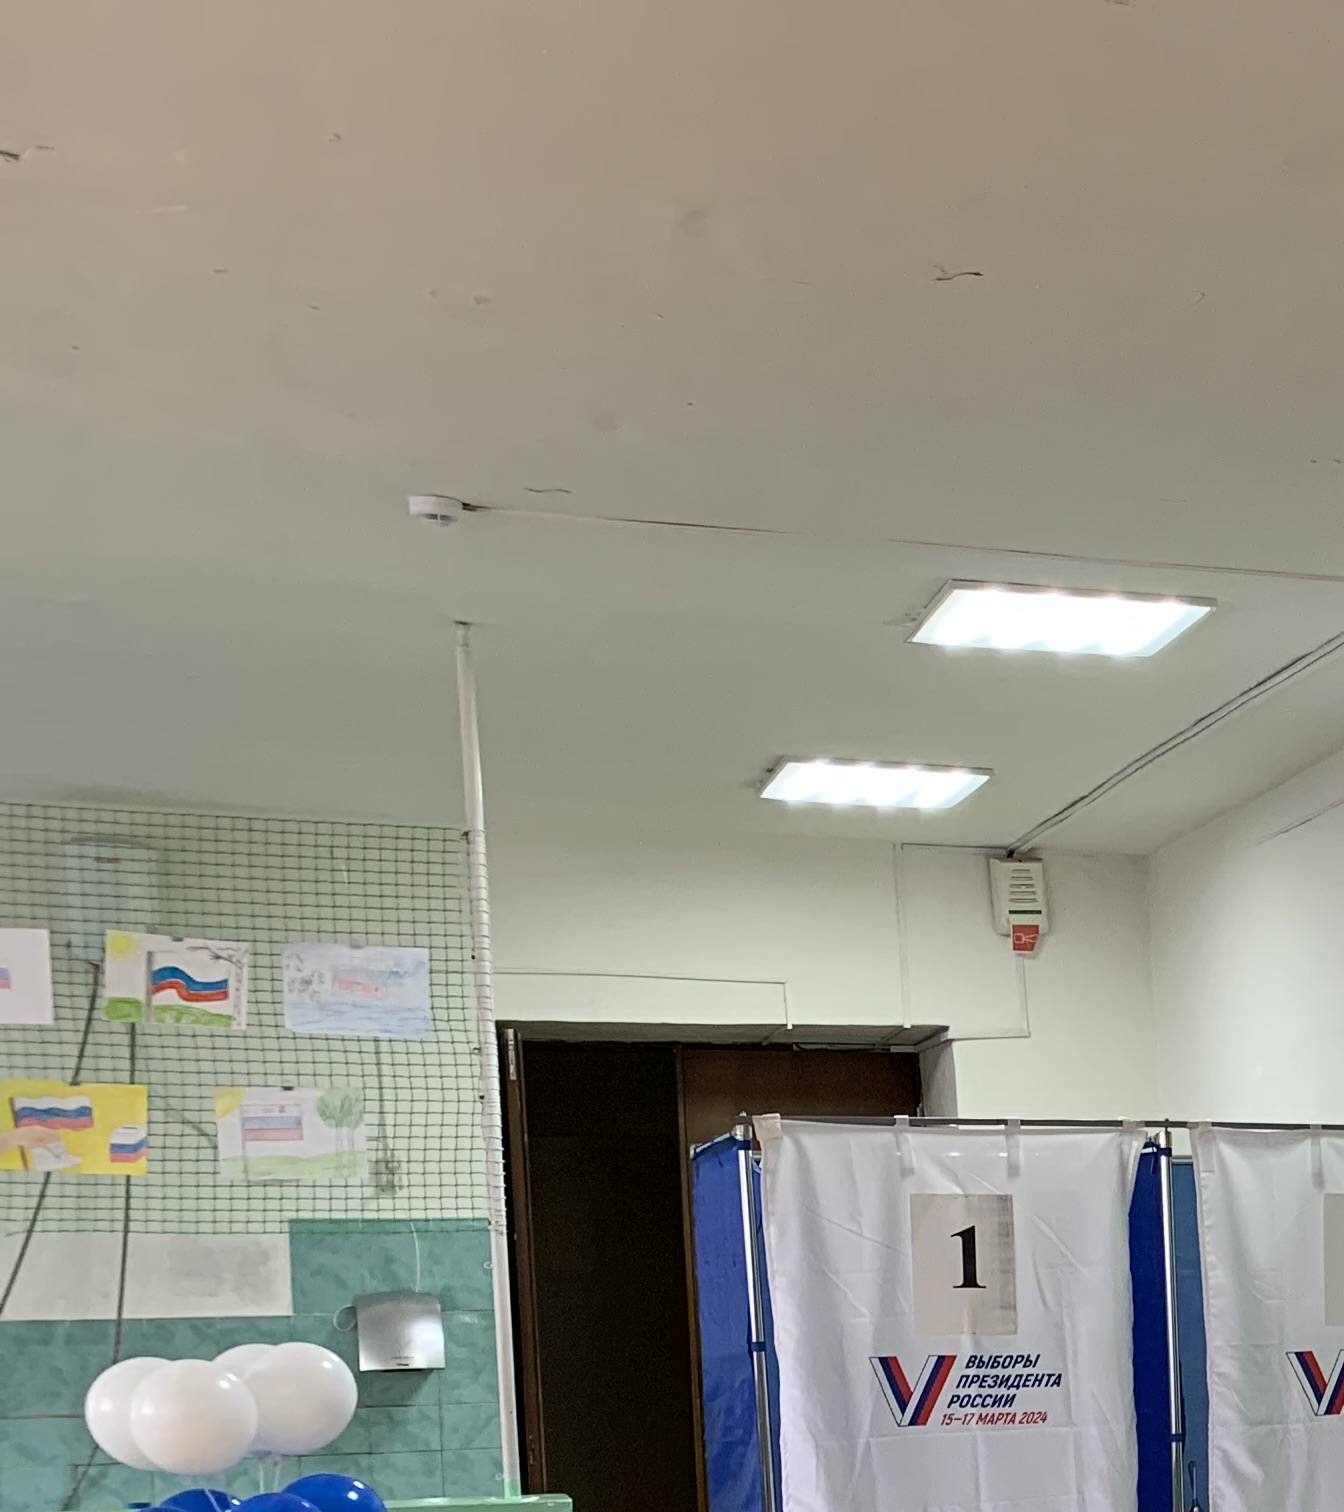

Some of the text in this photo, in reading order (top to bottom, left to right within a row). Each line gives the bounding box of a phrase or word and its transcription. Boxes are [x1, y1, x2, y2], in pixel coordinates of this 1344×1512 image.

[950, 1225, 987, 1289] 1
[965, 1354, 1041, 1369] ВЫБОРЫ
[955, 1373, 1062, 1391] ПРЕЗИДЕНТА
[947, 1393, 1017, 1409] РОССИИ
[975, 1412, 1017, 1426] МАРТА
[1018, 1411, 1048, 1425] 2024
